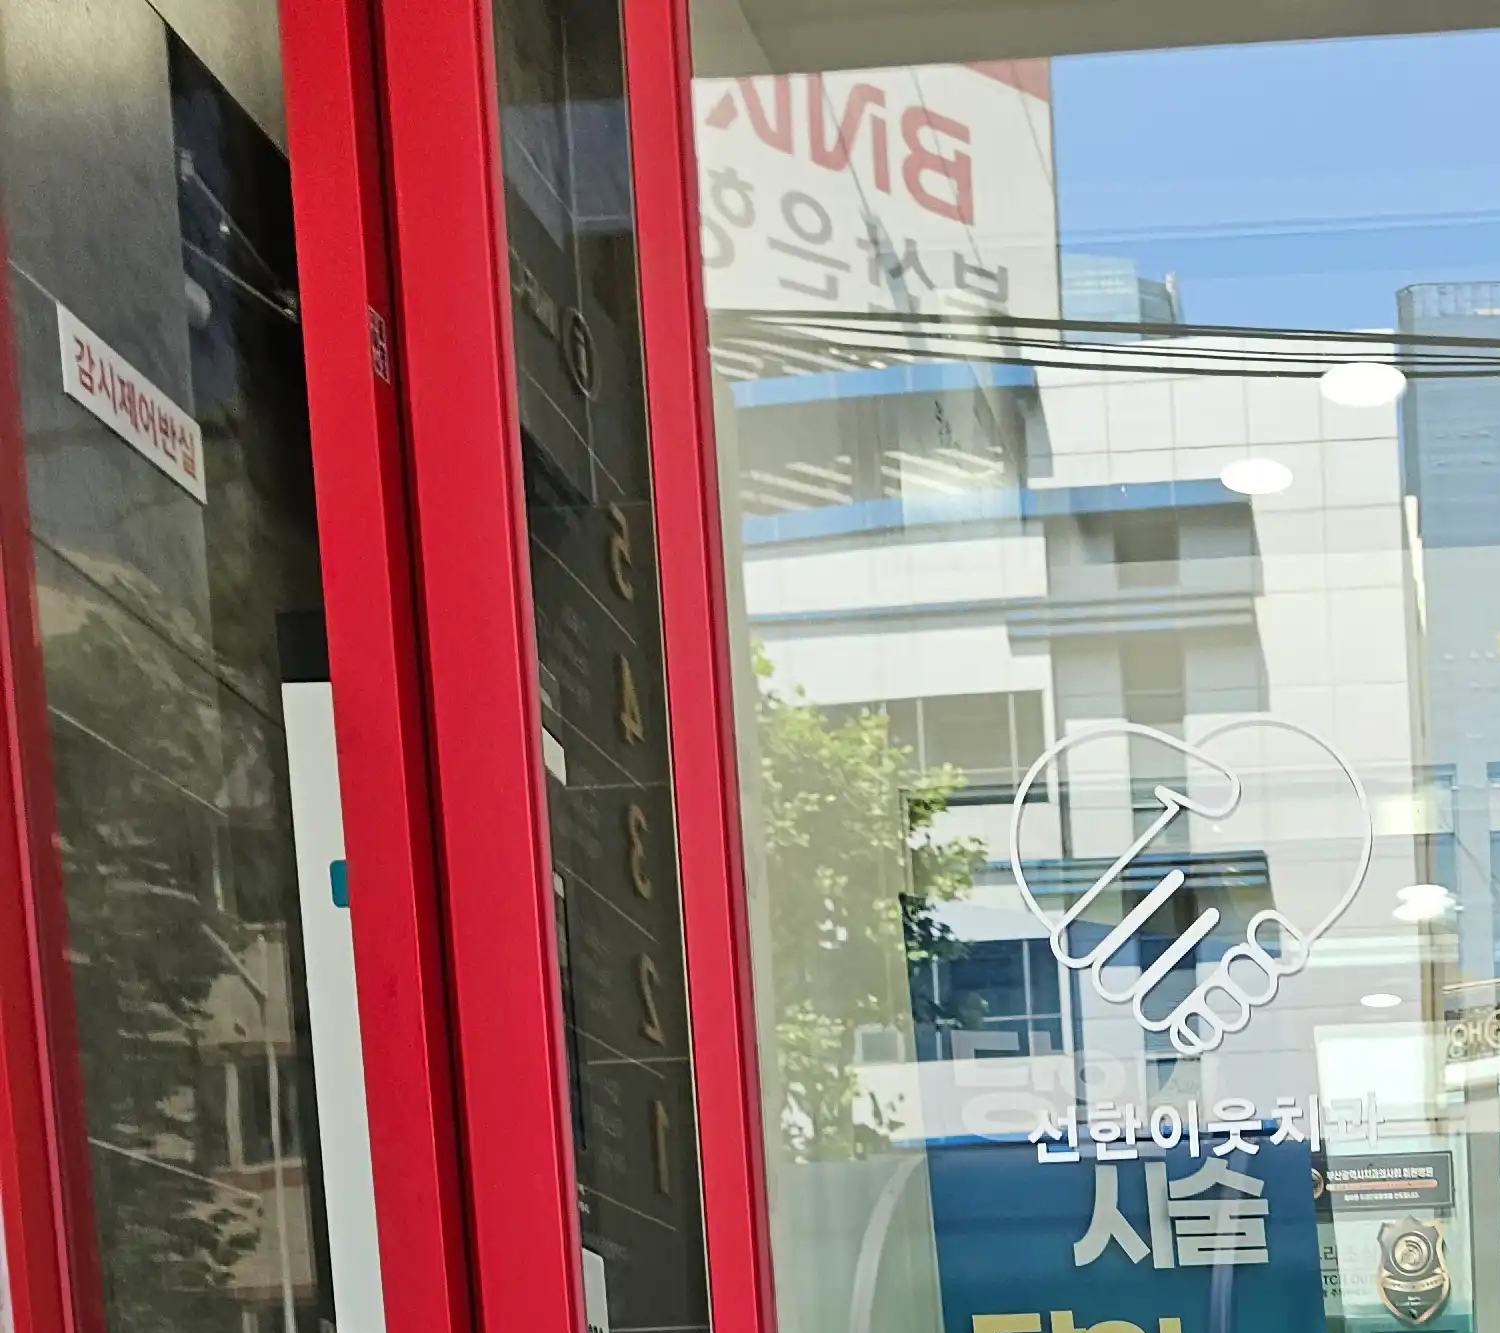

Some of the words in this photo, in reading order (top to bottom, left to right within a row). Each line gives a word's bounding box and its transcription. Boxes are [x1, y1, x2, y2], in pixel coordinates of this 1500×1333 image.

[73, 335, 197, 481] 감시제어반실
[1028, 1091, 1385, 1164] 선한이웃치과
[1073, 1157, 1270, 1268] 시술
